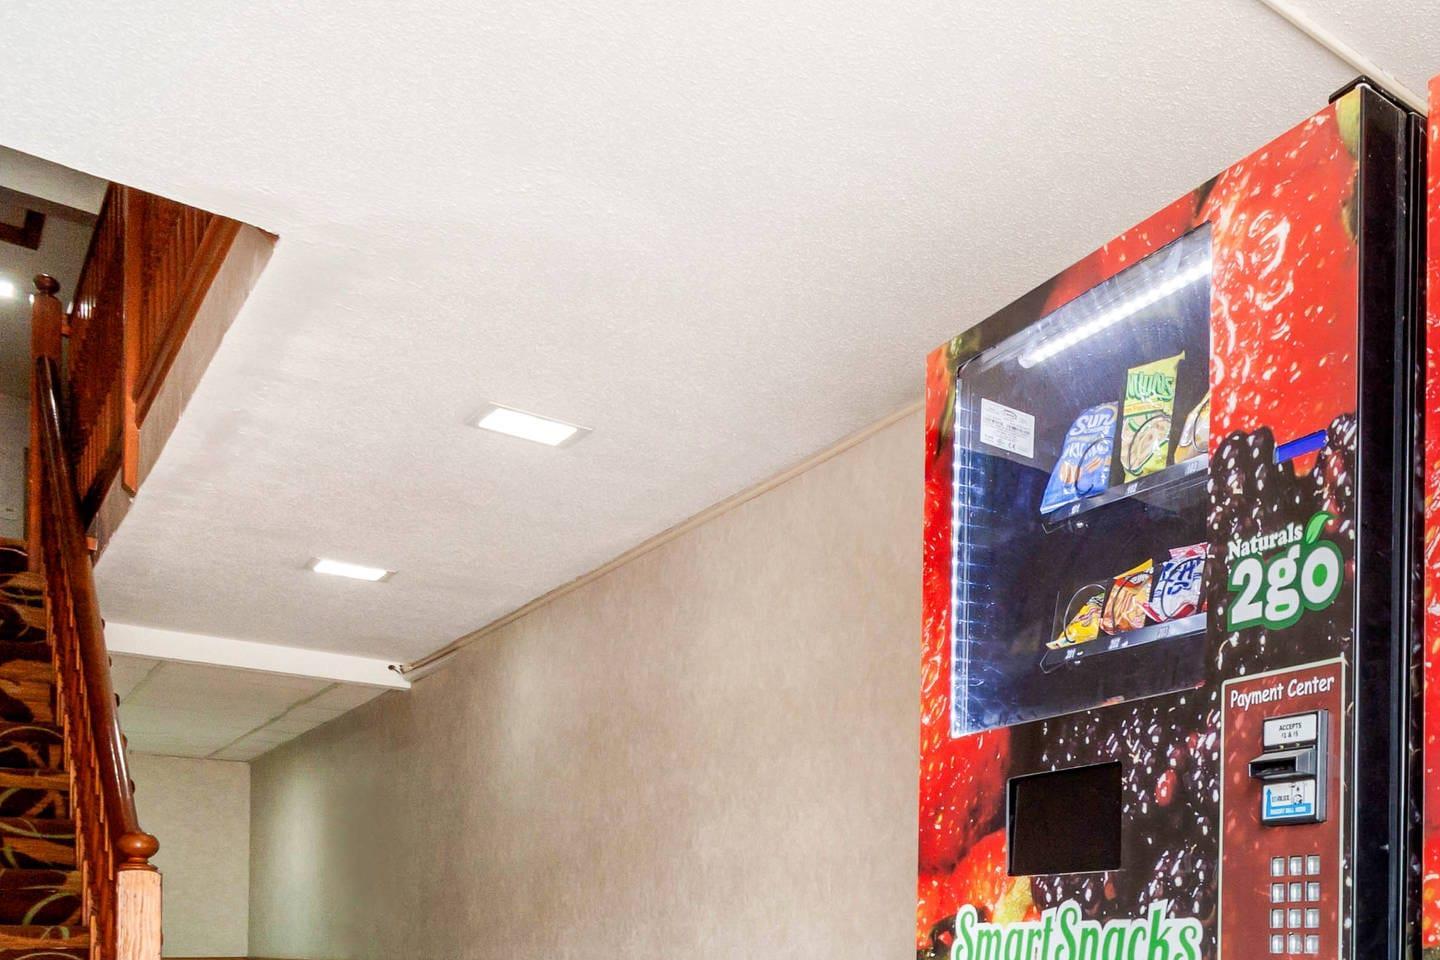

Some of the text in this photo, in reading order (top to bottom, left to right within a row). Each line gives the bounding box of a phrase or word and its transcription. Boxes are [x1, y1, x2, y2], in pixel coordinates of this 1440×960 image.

[1227, 522, 1303, 560] Naturals
[1231, 543, 1340, 625] 2go
[1230, 675, 1335, 711] Payment Center
[1279, 722, 1302, 731] ACCEPTS
